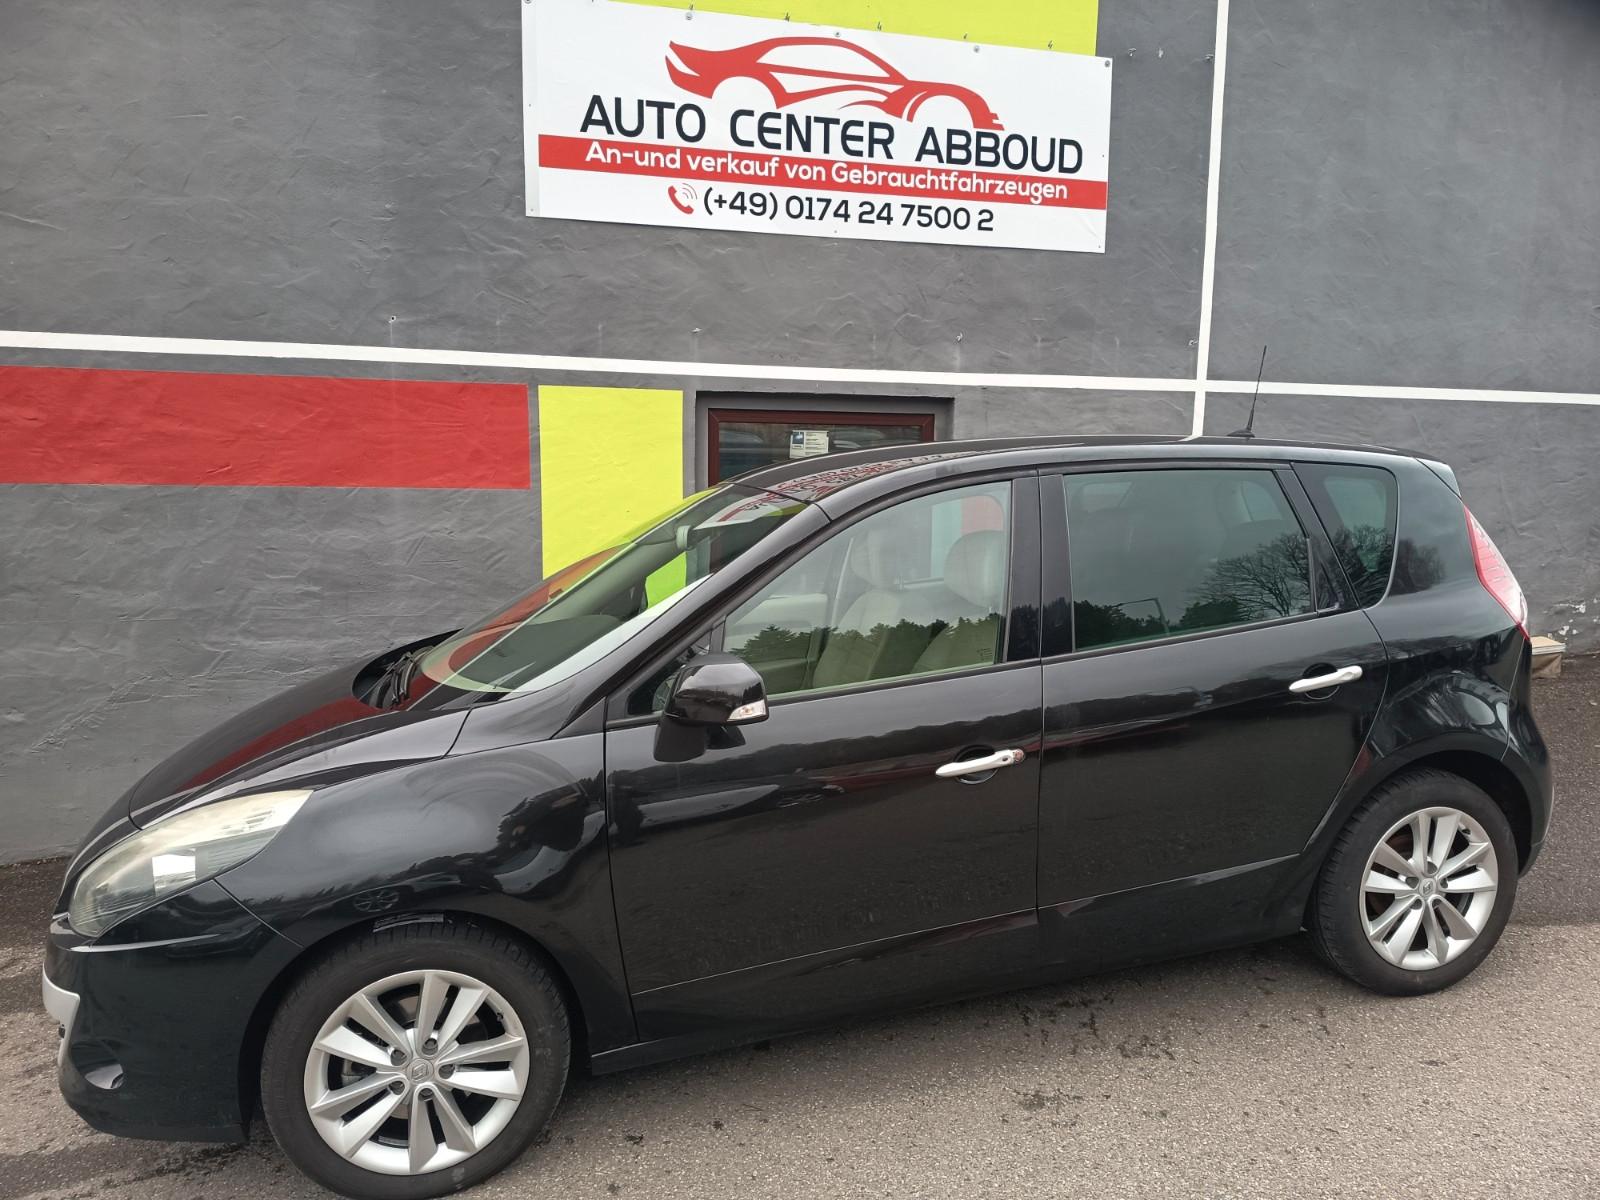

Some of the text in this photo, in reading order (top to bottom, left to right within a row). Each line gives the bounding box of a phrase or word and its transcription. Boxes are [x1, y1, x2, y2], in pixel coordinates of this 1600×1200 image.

[579, 94, 1083, 174] AUTO CENTER ABBOUD
[585, 140, 1068, 205] An-und verkauf von Gebrauchtfahrzeugen
[703, 186, 994, 232] (+49) 0174 24 7500 2
